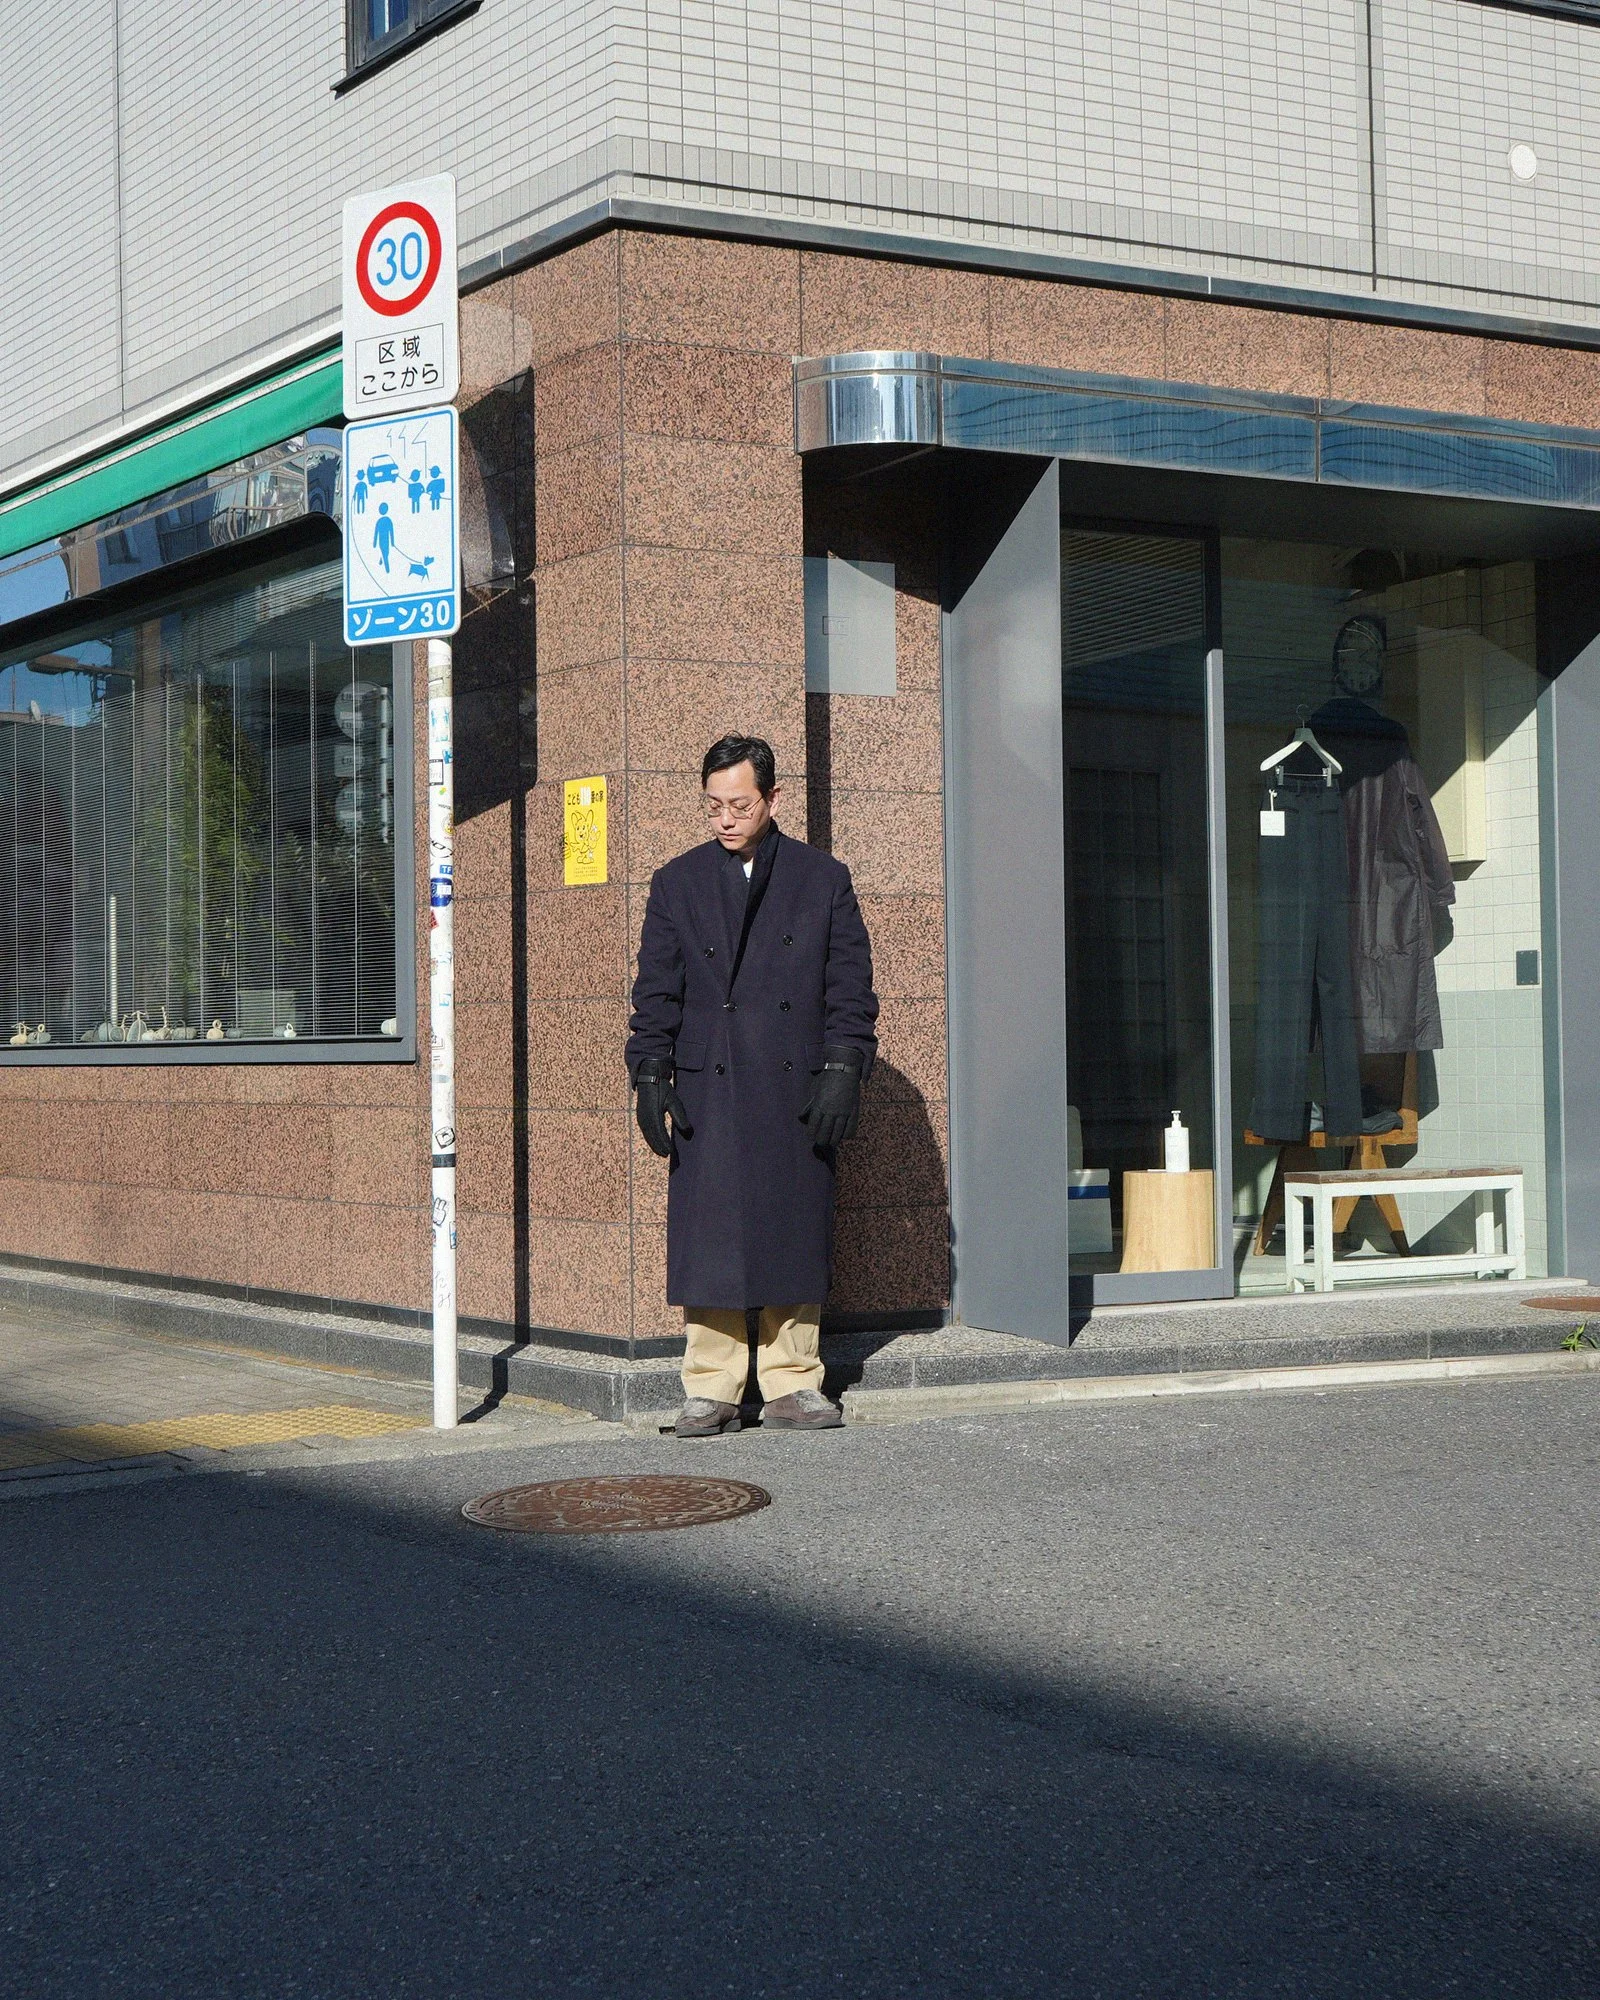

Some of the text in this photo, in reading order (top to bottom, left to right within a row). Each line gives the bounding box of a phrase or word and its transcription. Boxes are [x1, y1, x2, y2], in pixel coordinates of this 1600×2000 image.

[376, 231, 422, 286] 30
[379, 335, 421, 364] 区域
[361, 363, 439, 396] ここから
[352, 599, 450, 637] ゾーン30
